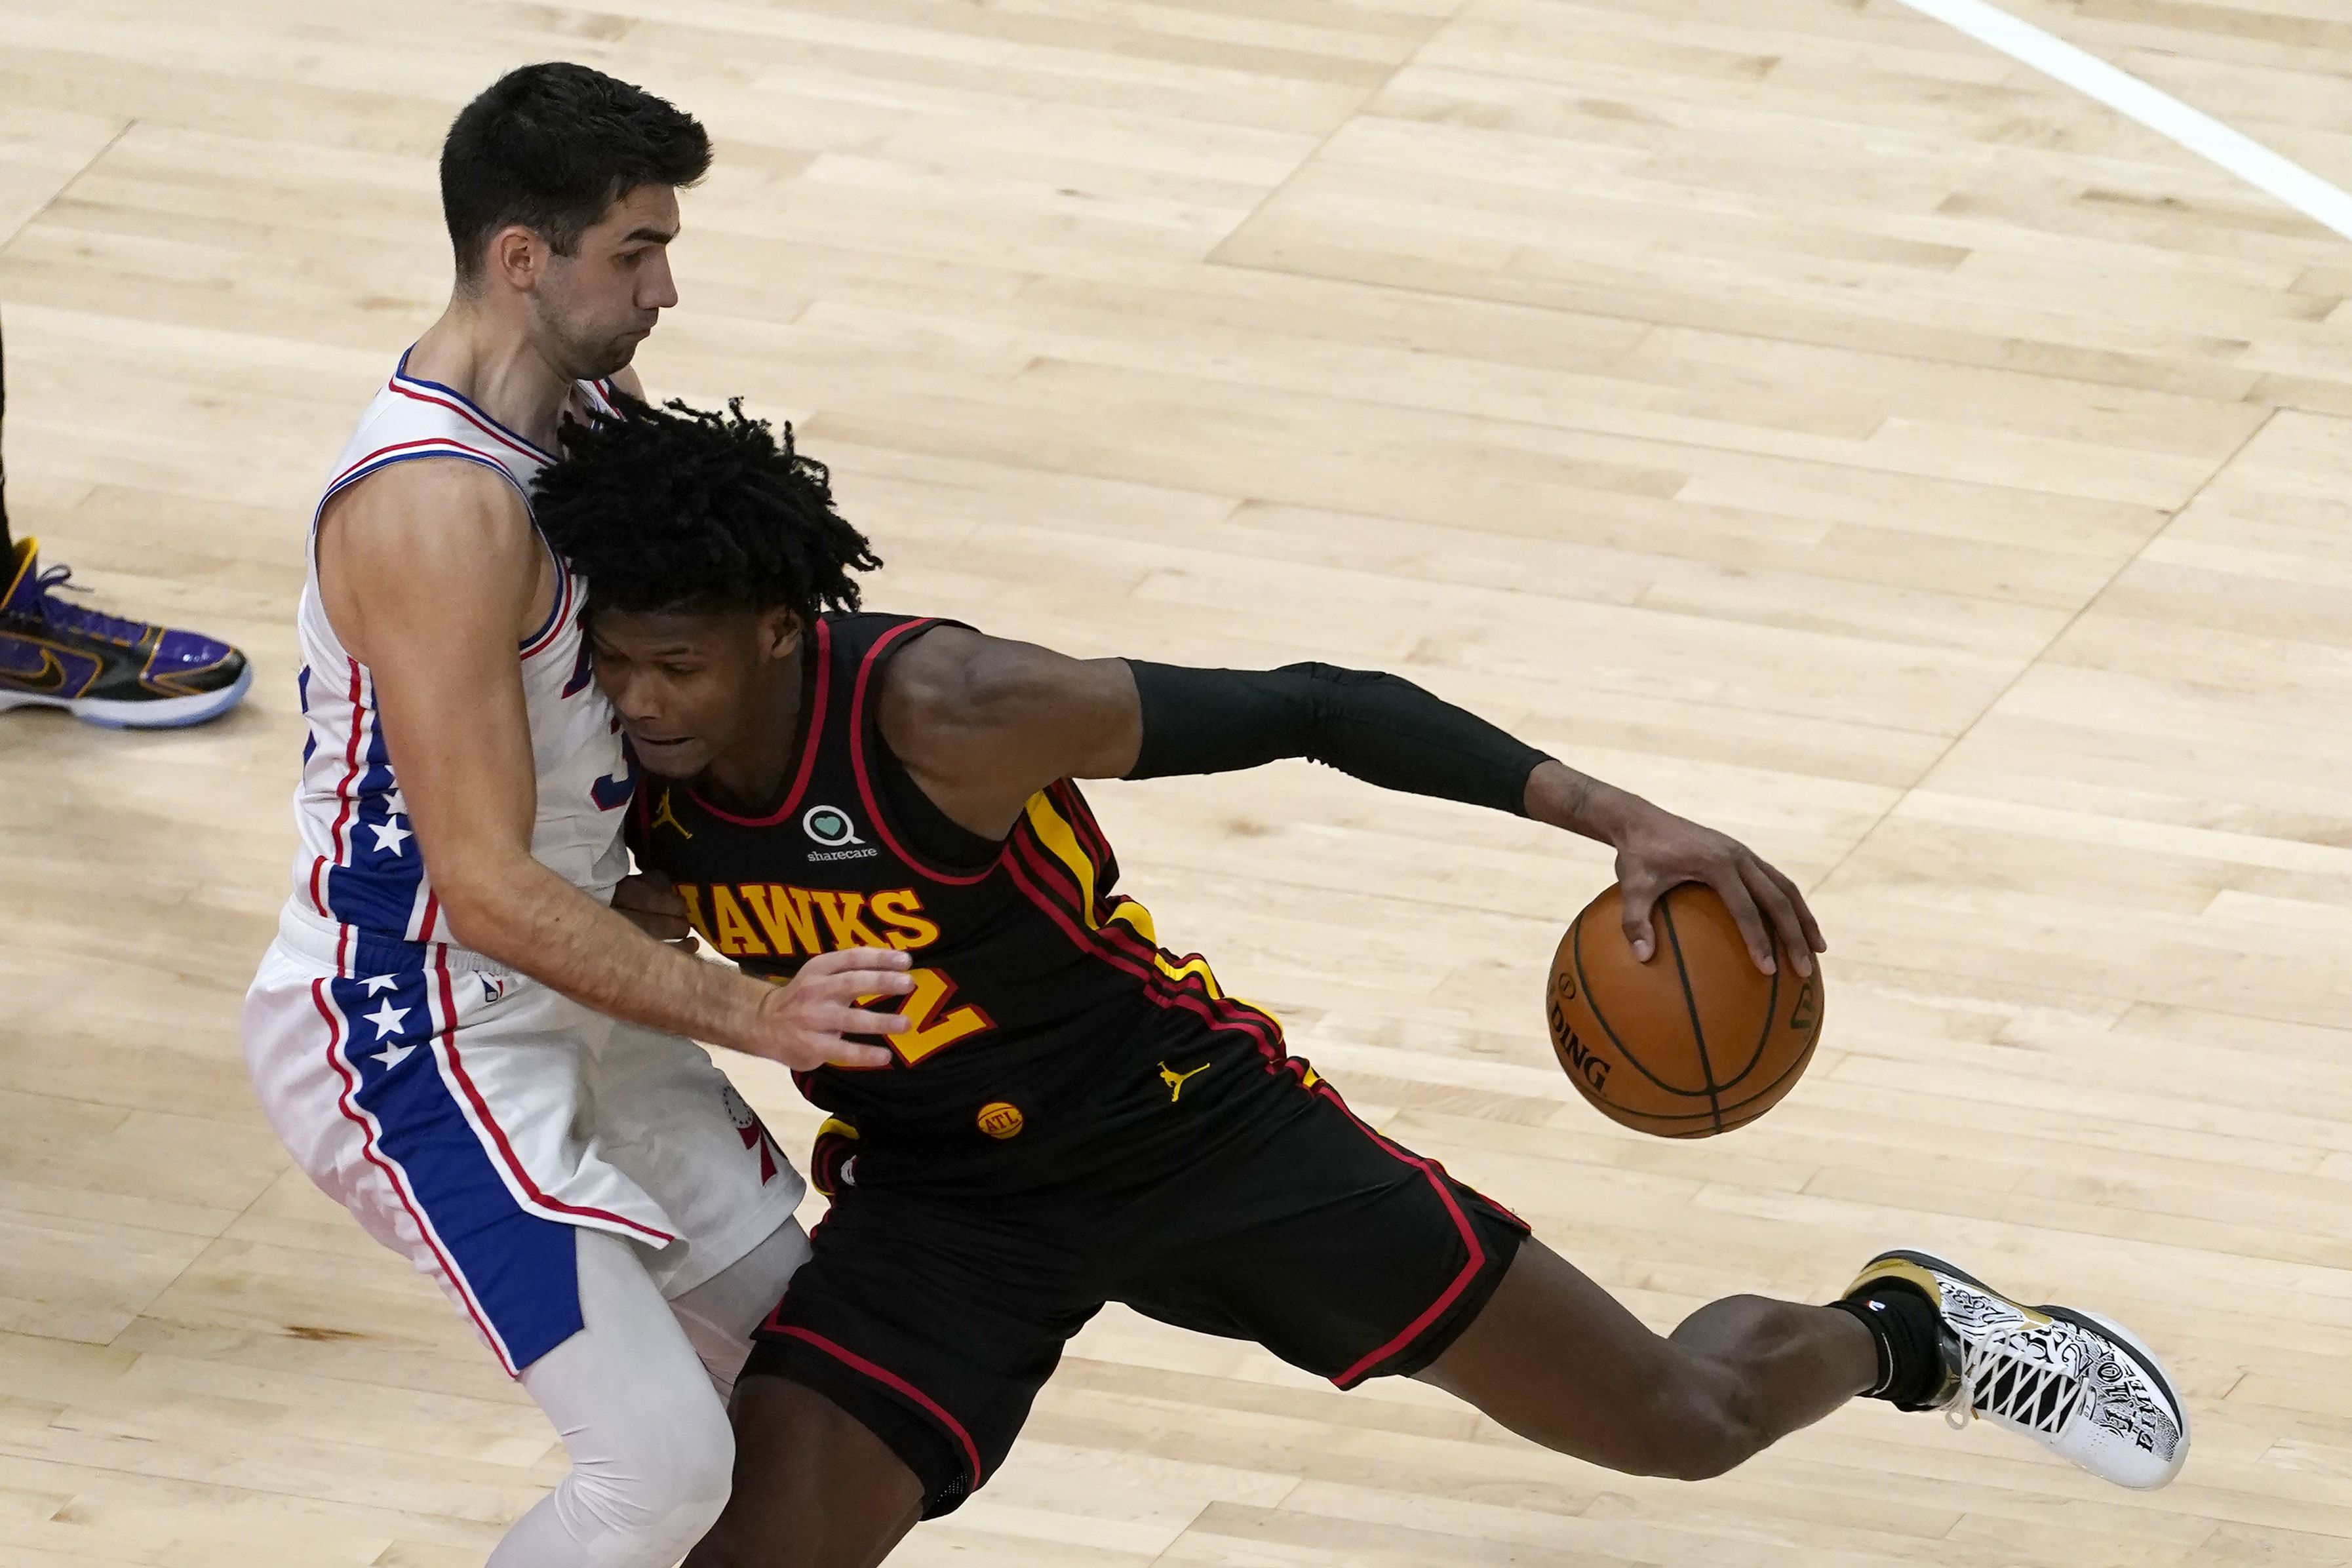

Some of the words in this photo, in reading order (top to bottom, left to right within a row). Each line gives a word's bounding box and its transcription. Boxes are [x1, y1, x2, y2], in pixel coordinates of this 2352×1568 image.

[807, 848, 878, 862] sharecare
[768, 968, 997, 1070] 2
[985, 1111, 1019, 1132] ATL
